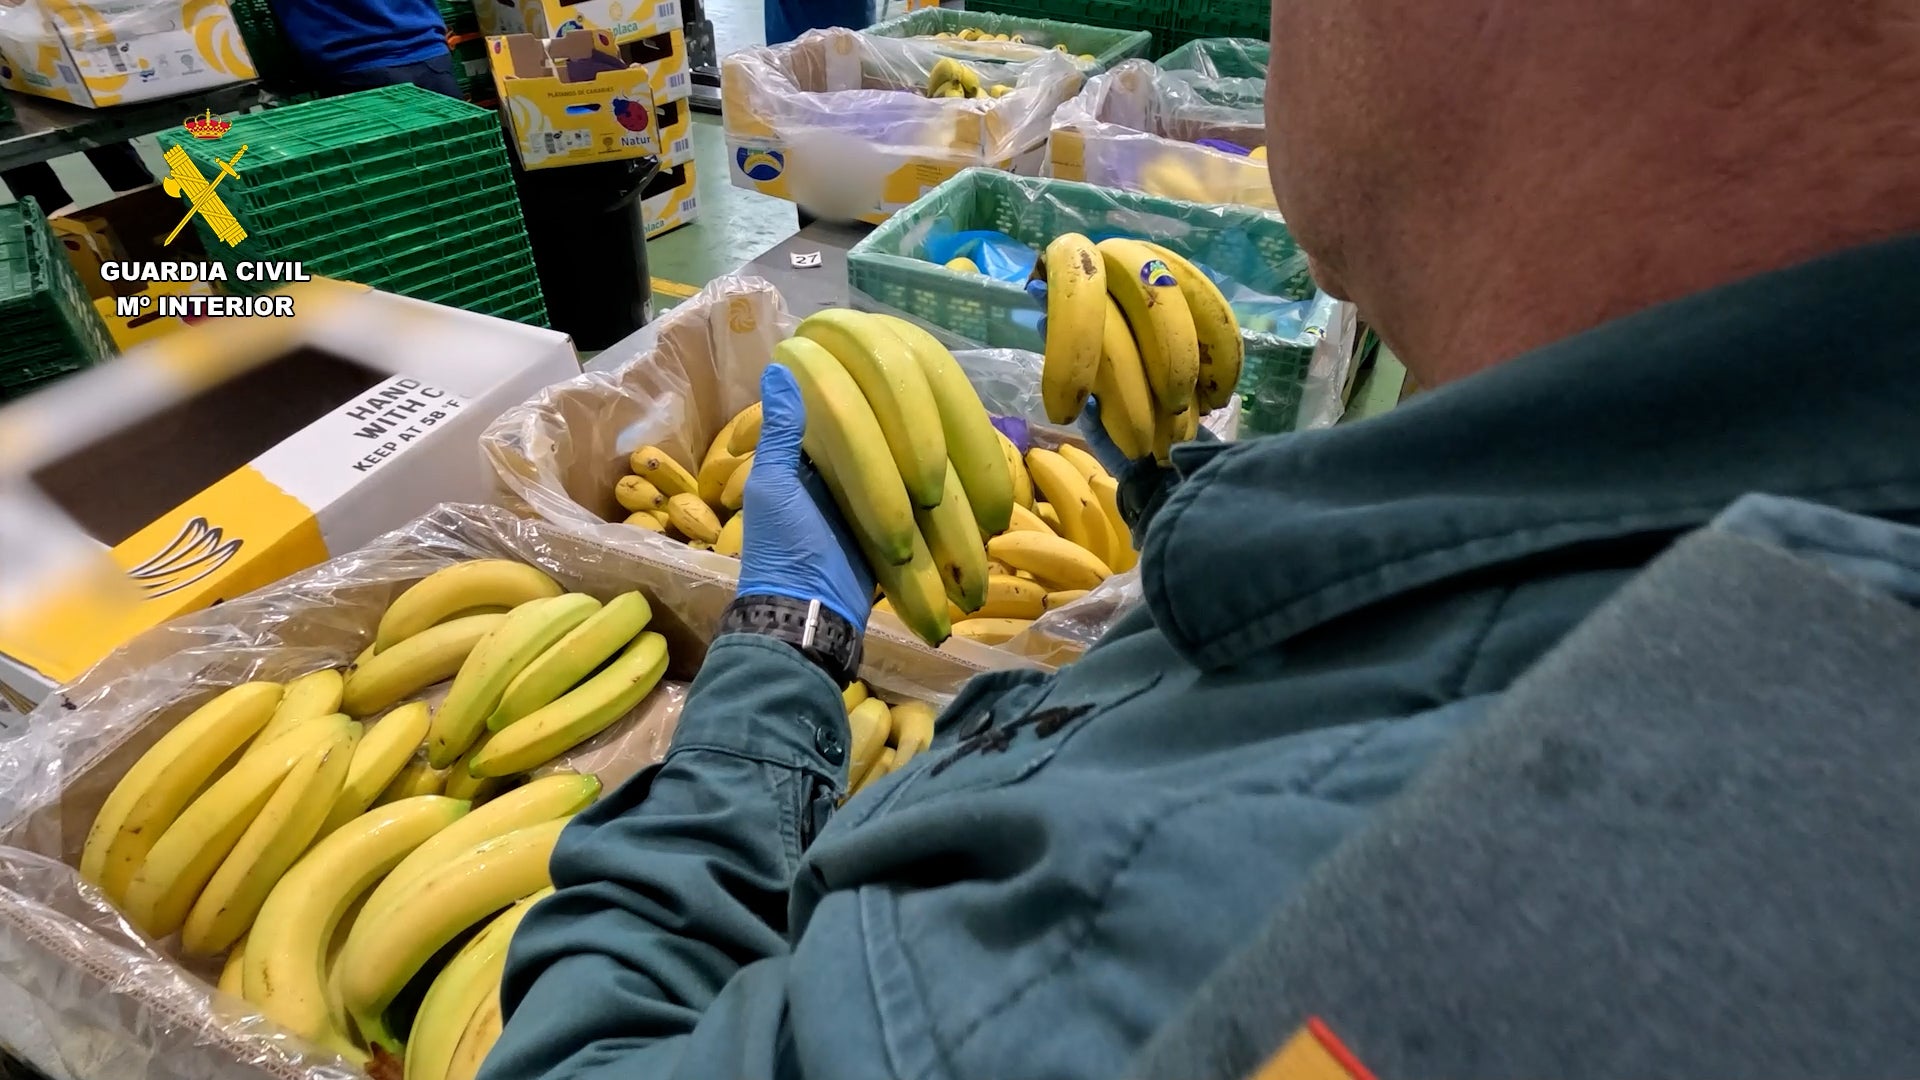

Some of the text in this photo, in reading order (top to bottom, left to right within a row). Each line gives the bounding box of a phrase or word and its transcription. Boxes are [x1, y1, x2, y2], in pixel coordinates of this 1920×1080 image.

[608, 22, 639, 36] placa
[621, 135, 650, 147] Natur
[795, 254, 818, 265] 27
[345, 378, 421, 421] HAND
[352, 387, 445, 440] WITH C
[352, 441, 398, 472] KEEP
[398, 425, 423, 442] AT
